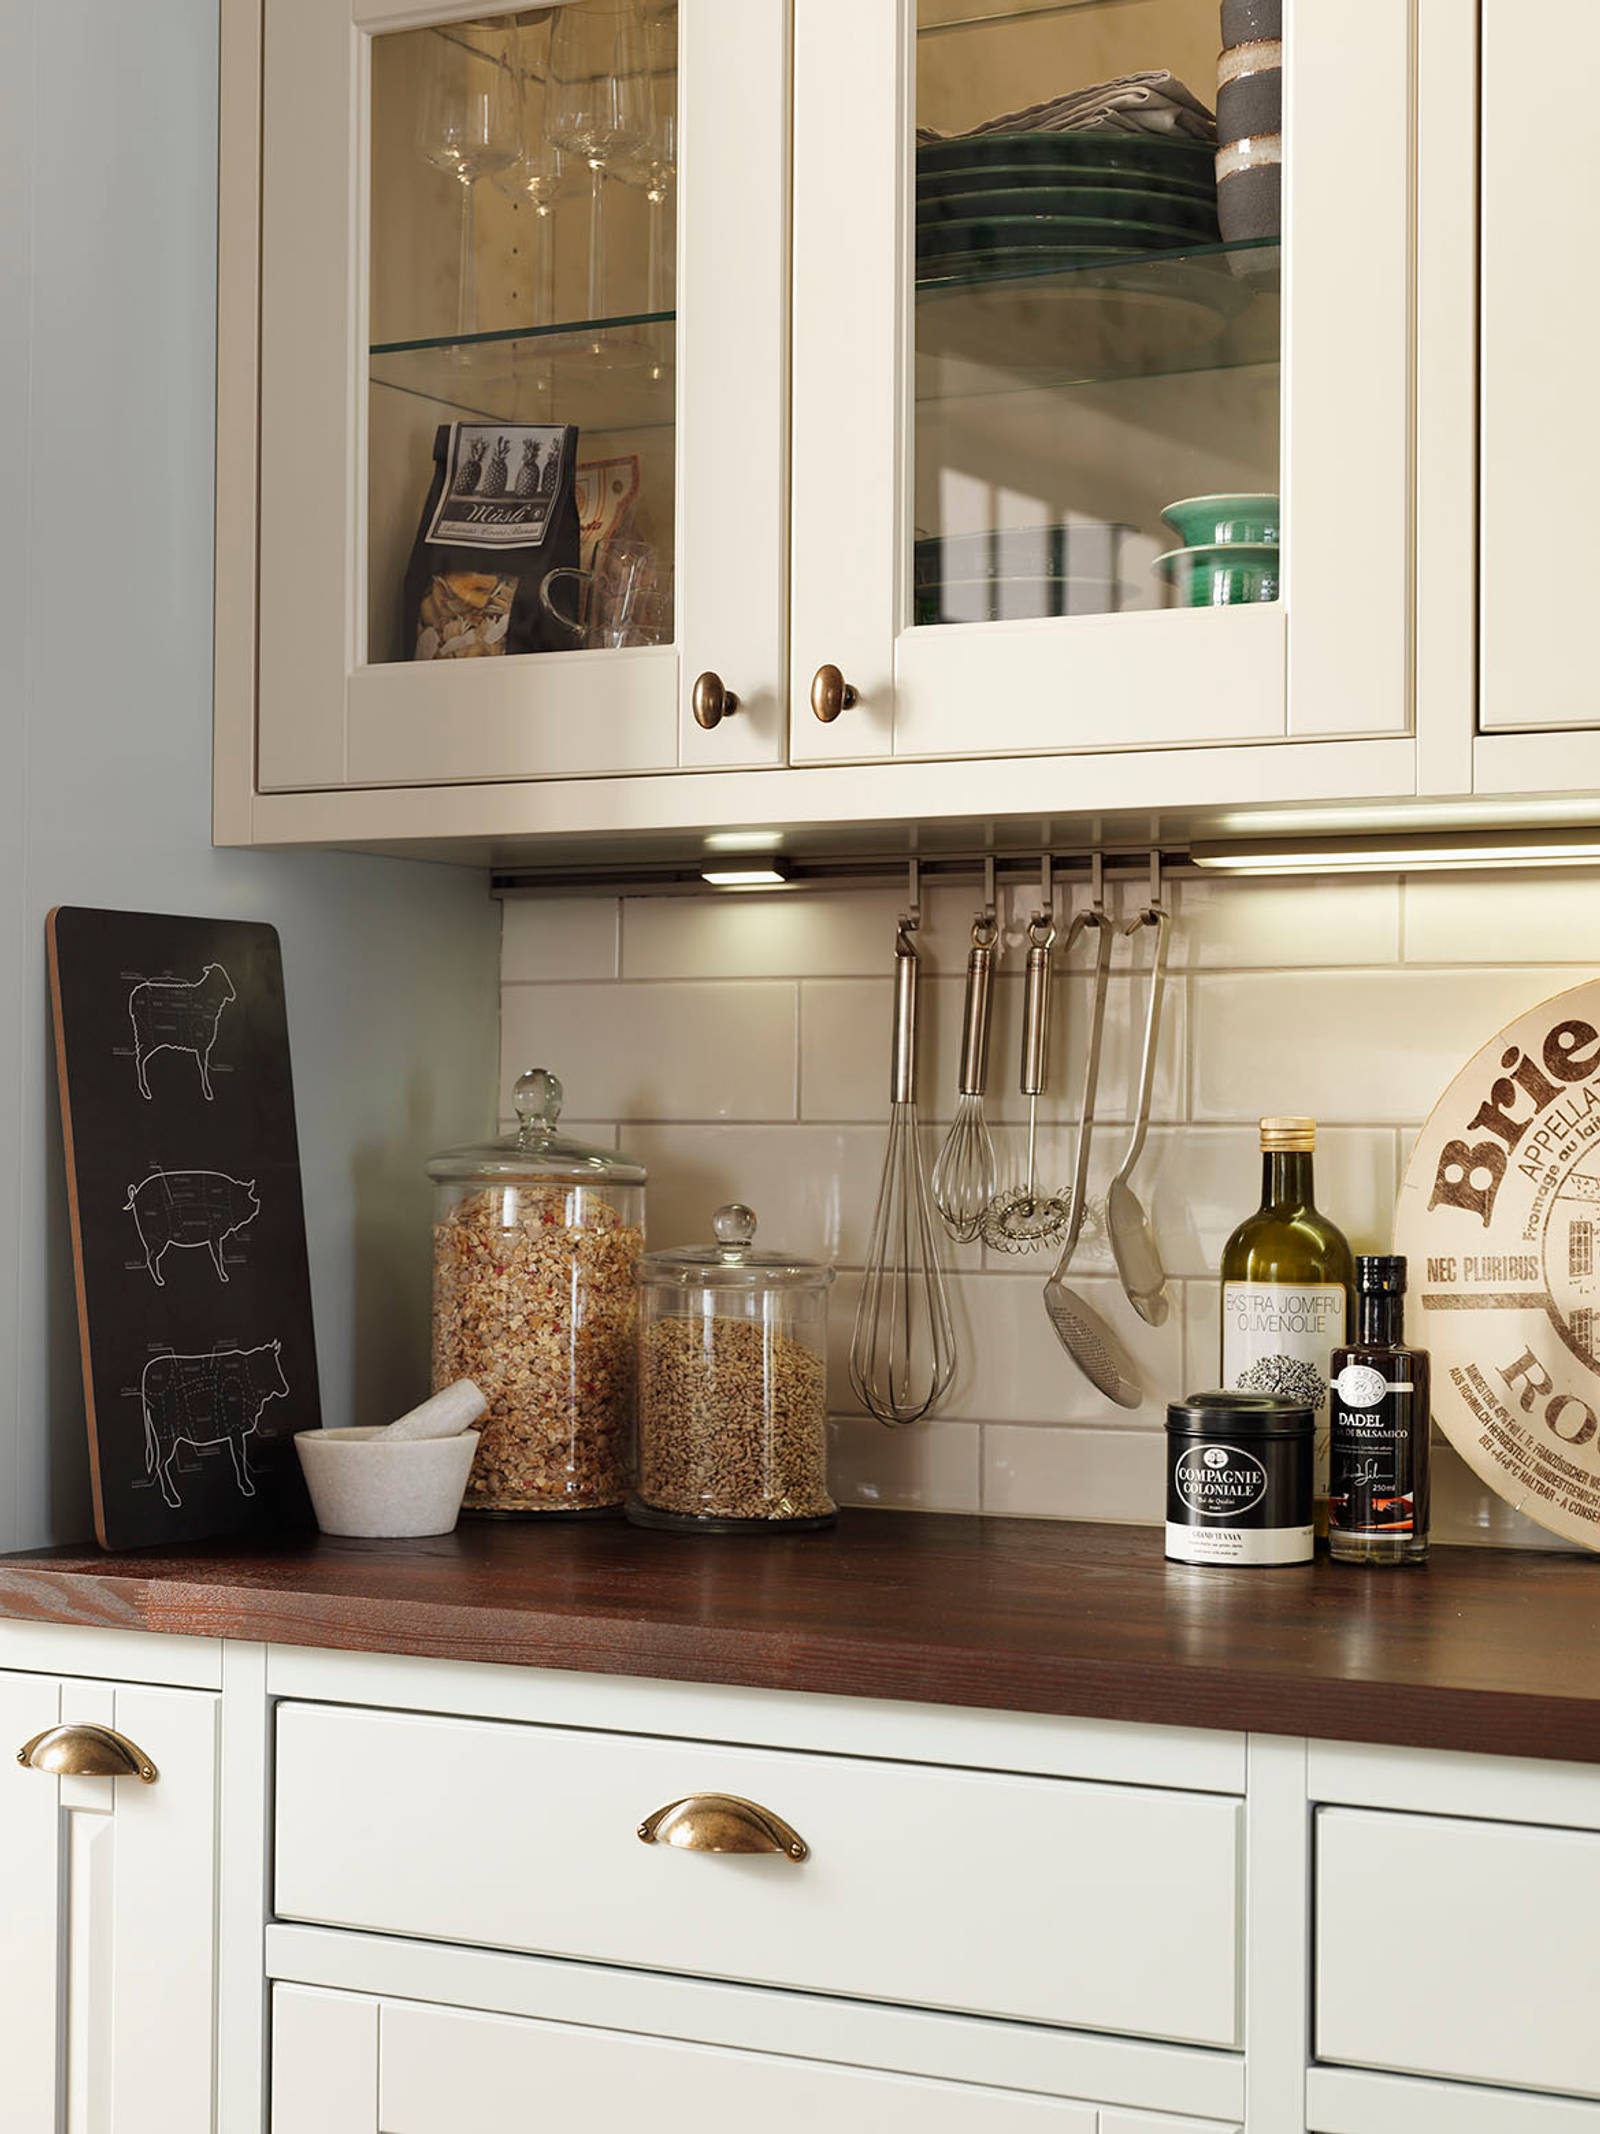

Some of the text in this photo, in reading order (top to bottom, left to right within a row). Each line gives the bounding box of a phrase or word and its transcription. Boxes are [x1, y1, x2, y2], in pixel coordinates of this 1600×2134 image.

[466, 503, 531, 523] Müsli
[1426, 1019, 1600, 1228] Brie
[1518, 1078, 1600, 1183] APPELLA
[1522, 1164, 1560, 1240] Fromage
[1558, 1140, 1578, 1162] au
[1427, 1255, 1539, 1282] NEC PLURIBUS
[1226, 1293, 1342, 1315] EKSTRA JOMFRU
[1338, 1412, 1385, 1428] DADEL
[1495, 1344, 1600, 1453] RO
[1355, 1428, 1408, 1439] BALSAMICO
[1448, 1367, 1600, 1508] AUS ROHMILCH HERGESTELLT MINDESTGEWICH
[1463, 1363, 1499, 1410] MINDESTENS
[1532, 1442, 1590, 1486] FRANZÖSISCHER
[1178, 1467, 1262, 1484] COMPAGNIE
[1183, 1481, 1255, 1497] COLONIALE
[1478, 1434, 1495, 1452] BEI
[1518, 1470, 1556, 1502] HALTBAR
[1560, 1497, 1569, 1510] A
